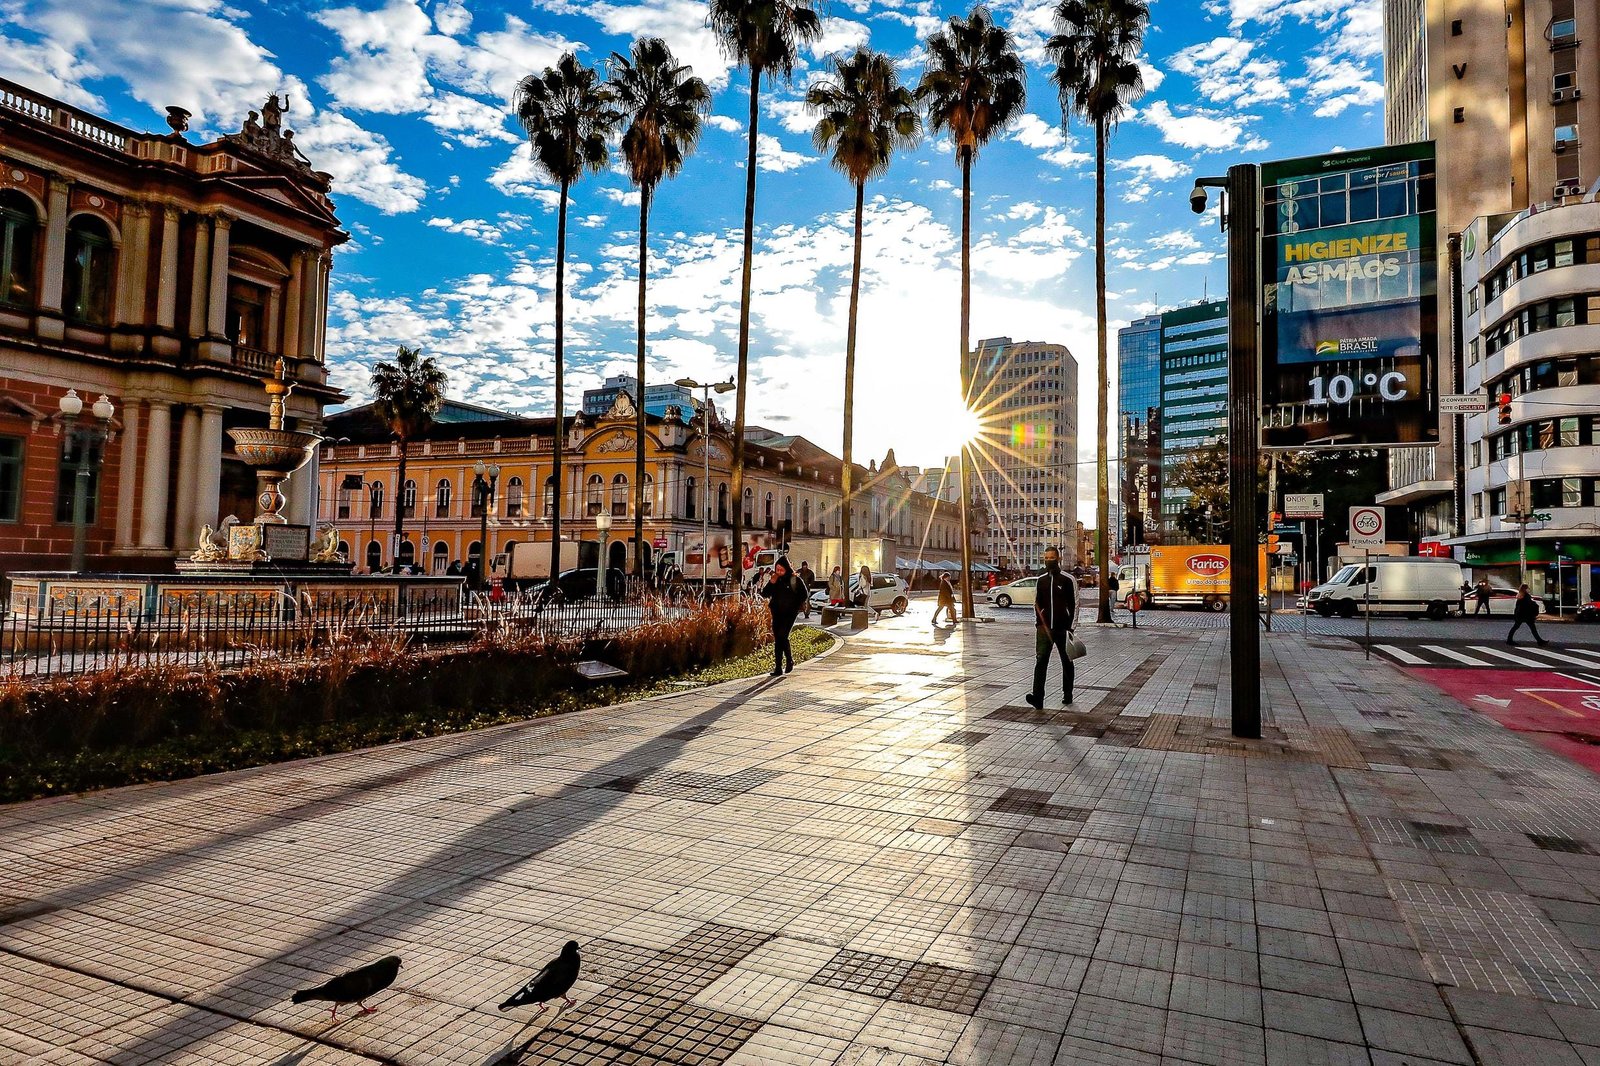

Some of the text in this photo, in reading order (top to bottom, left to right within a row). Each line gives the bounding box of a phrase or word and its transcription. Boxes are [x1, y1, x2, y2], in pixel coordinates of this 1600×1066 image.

[1285, 233, 1407, 261] HIGIENIZE
[1285, 257, 1400, 285] AS MÃOS
[1340, 341, 1378, 351] BRASIL
[1309, 374, 1354, 404] 10
[1191, 558, 1225, 570] Farias
